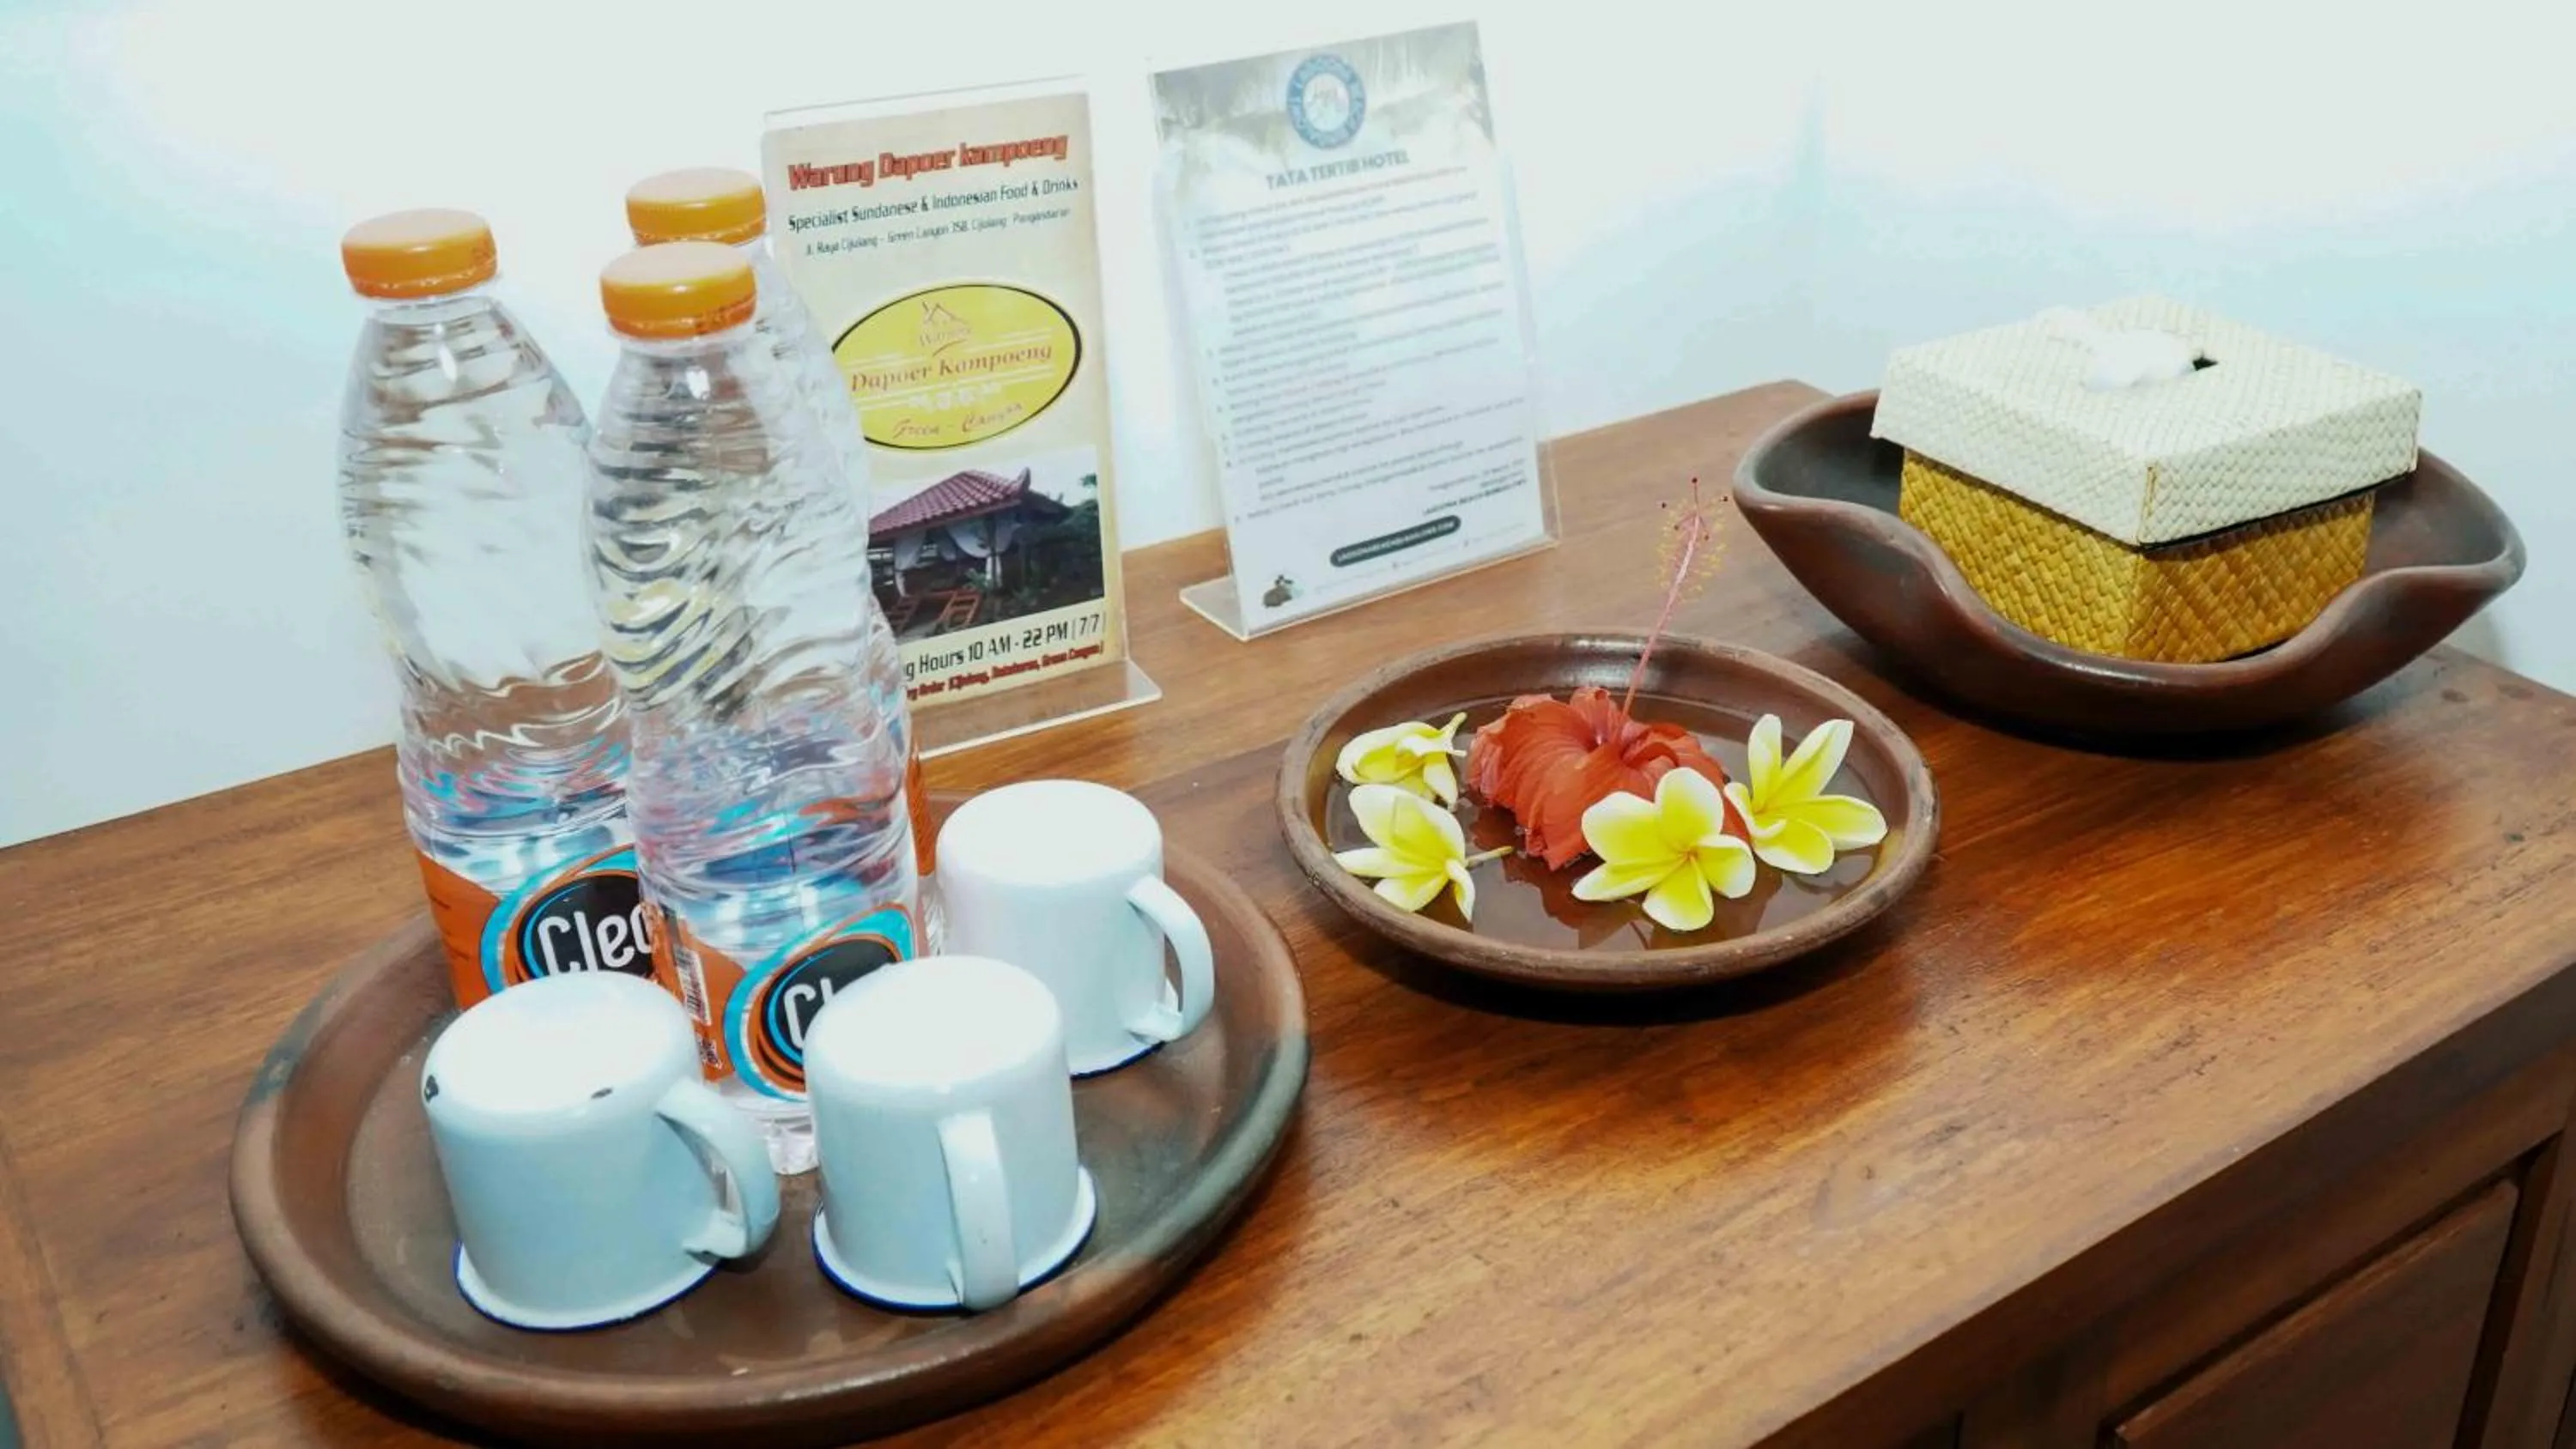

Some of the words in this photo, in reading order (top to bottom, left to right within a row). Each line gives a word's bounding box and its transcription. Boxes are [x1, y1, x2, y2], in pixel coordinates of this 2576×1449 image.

[787, 160, 875, 191] Warung
[878, 149, 957, 181] Dapoer
[1266, 169, 1308, 190] TATA
[1363, 149, 1410, 169] HOTEL
[788, 209, 848, 233] Specialist
[852, 202, 918, 223] Sundanese
[920, 195, 929, 211] &
[933, 185, 998, 210] Indonesian
[1000, 181, 1028, 199] Food
[1031, 180, 1040, 197] &
[1042, 178, 1078, 196] Drinks
[852, 362, 933, 392] Dapoer
[919, 649, 964, 674] Hours
[968, 640, 984, 663] 10
[988, 634, 1012, 657] AM
[1023, 627, 1042, 650] 22
[1047, 620, 1068, 644] PM
